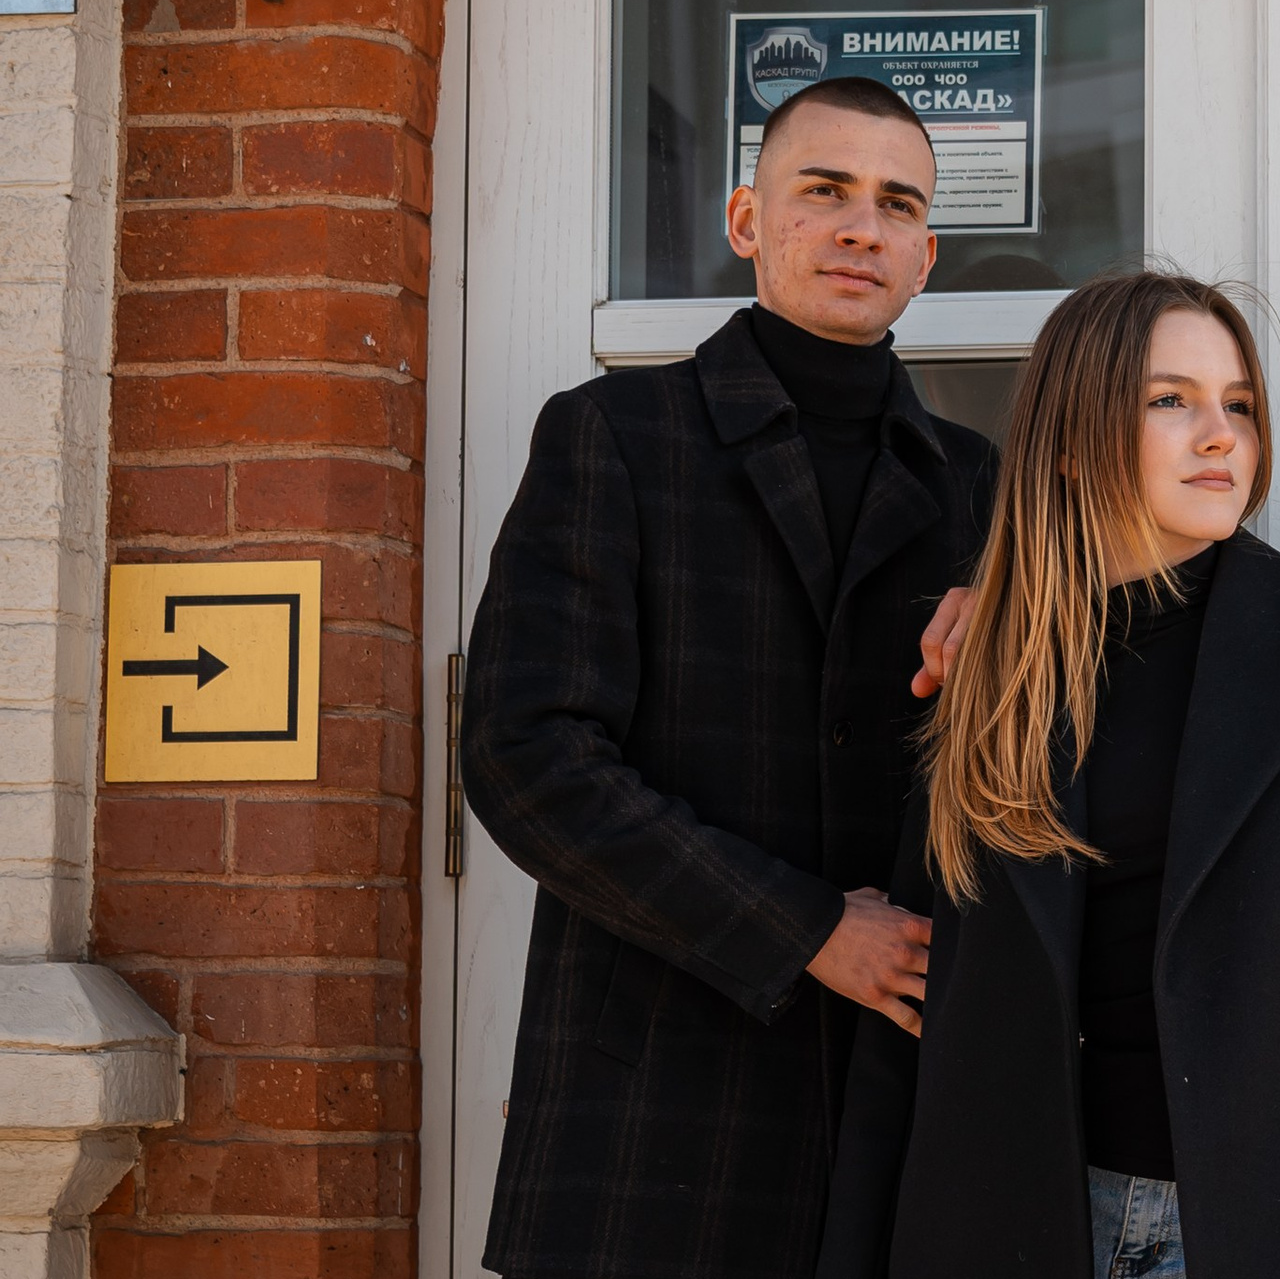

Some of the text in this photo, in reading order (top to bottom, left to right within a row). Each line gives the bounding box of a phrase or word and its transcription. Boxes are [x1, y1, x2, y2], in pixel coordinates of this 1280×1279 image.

[843, 30, 1020, 53] ВНИМАНИЕ!
[883, 60, 979, 70] ОБЪЕКТ ОХРАНЯЕТСЯ
[755, 67, 818, 78] КАСКАД ГРУПП
[892, 73, 967, 86] ООО ЧОО
